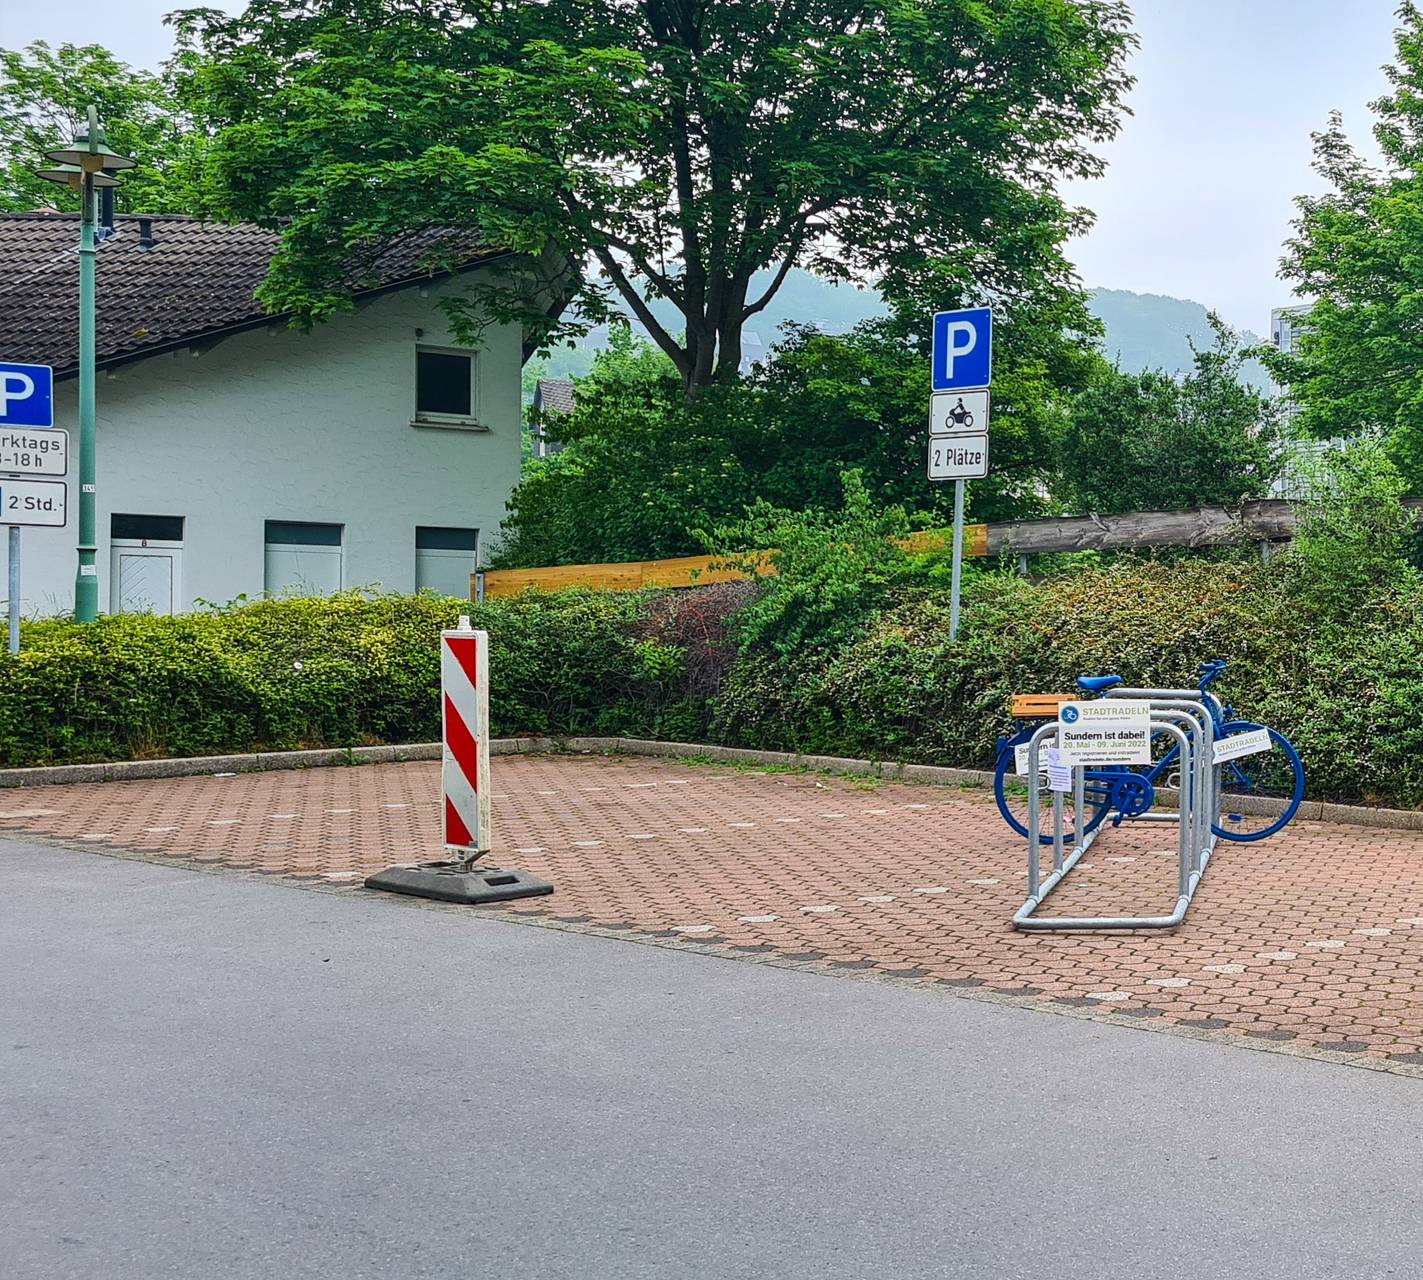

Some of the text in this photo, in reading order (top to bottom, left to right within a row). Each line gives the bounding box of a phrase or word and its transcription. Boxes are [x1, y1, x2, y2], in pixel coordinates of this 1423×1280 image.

[946, 320, 977, 379] P
[0, 371, 35, 416] P
[2, 434, 60, 453] rktags
[0, 452, 30, 467] -18
[934, 448, 982, 467] 2 Plätze
[9, 495, 57, 511] 2 Std.
[1083, 707, 1149, 716] STADTRADELN
[1064, 731, 1146, 741] Sundern ist dabei!
[1111, 740, 1126, 748] Juni
[1127, 740, 1147, 748] 2022
[1216, 734, 1269, 753] STADTRADELN
